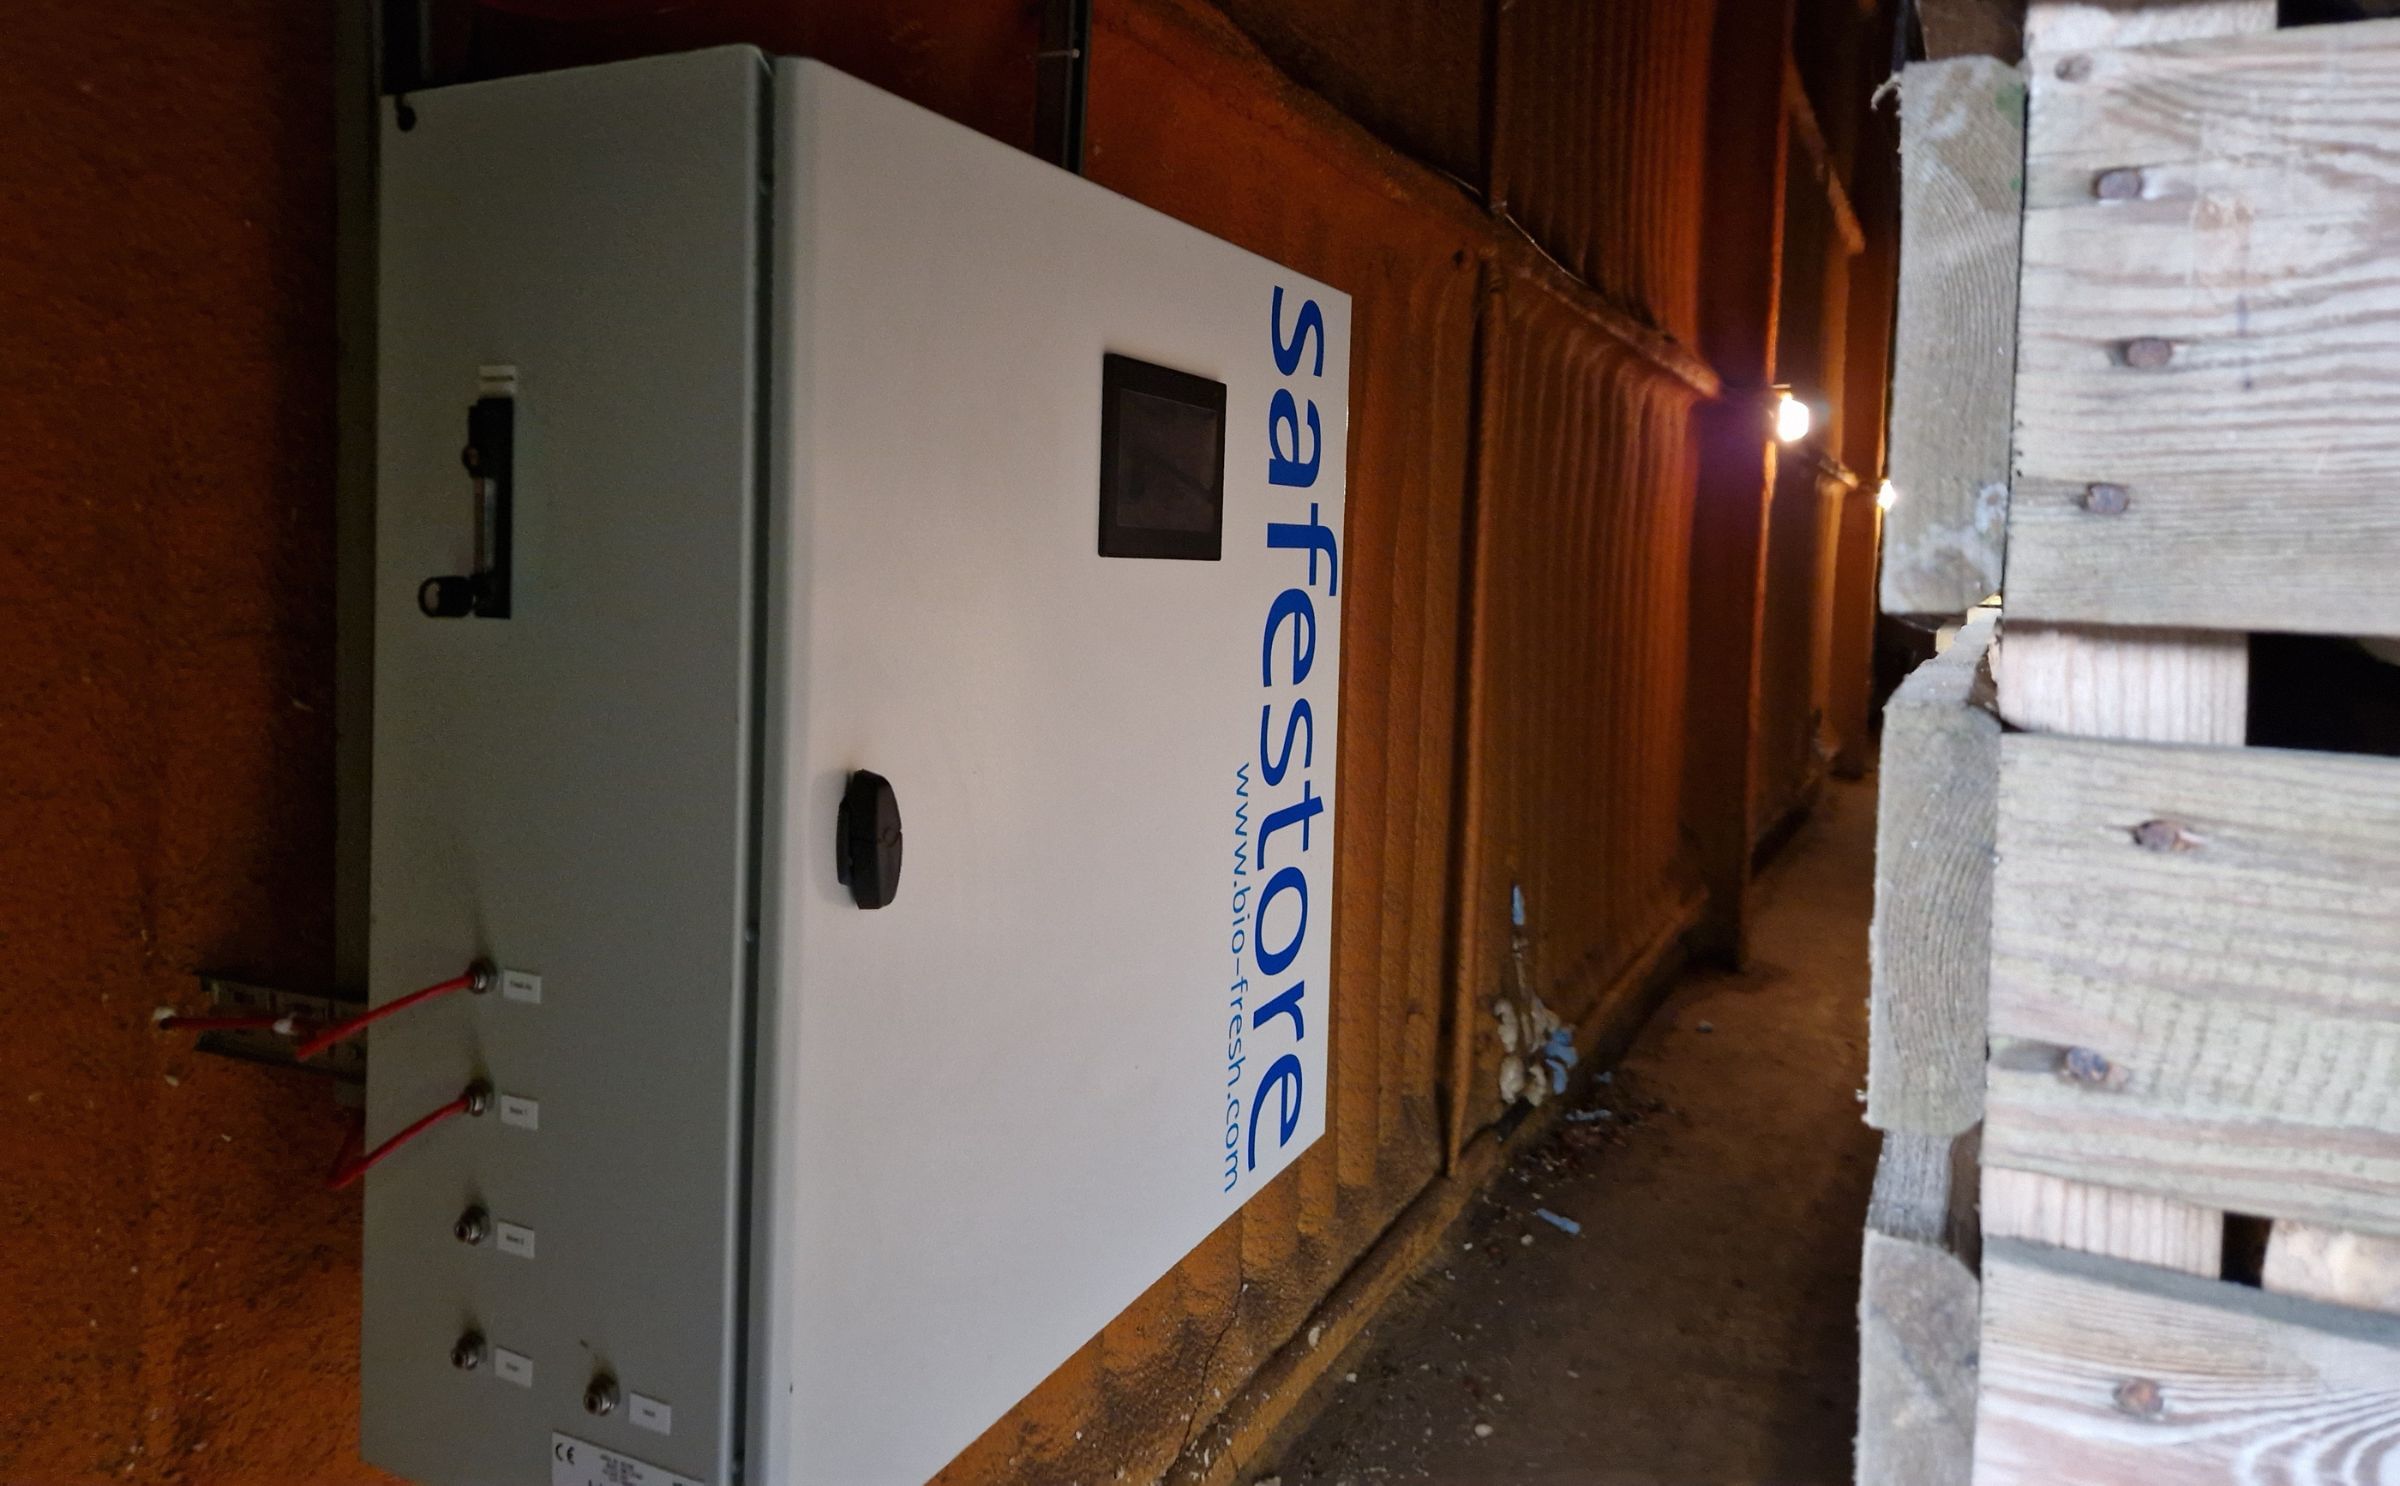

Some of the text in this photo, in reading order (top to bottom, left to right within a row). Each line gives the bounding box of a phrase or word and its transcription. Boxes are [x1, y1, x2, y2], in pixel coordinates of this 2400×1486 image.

[1249, 286, 1340, 1173] safestore
[1224, 763, 1250, 1193] www.bio-fresh.com
[555, 1443, 575, 1466] CE
